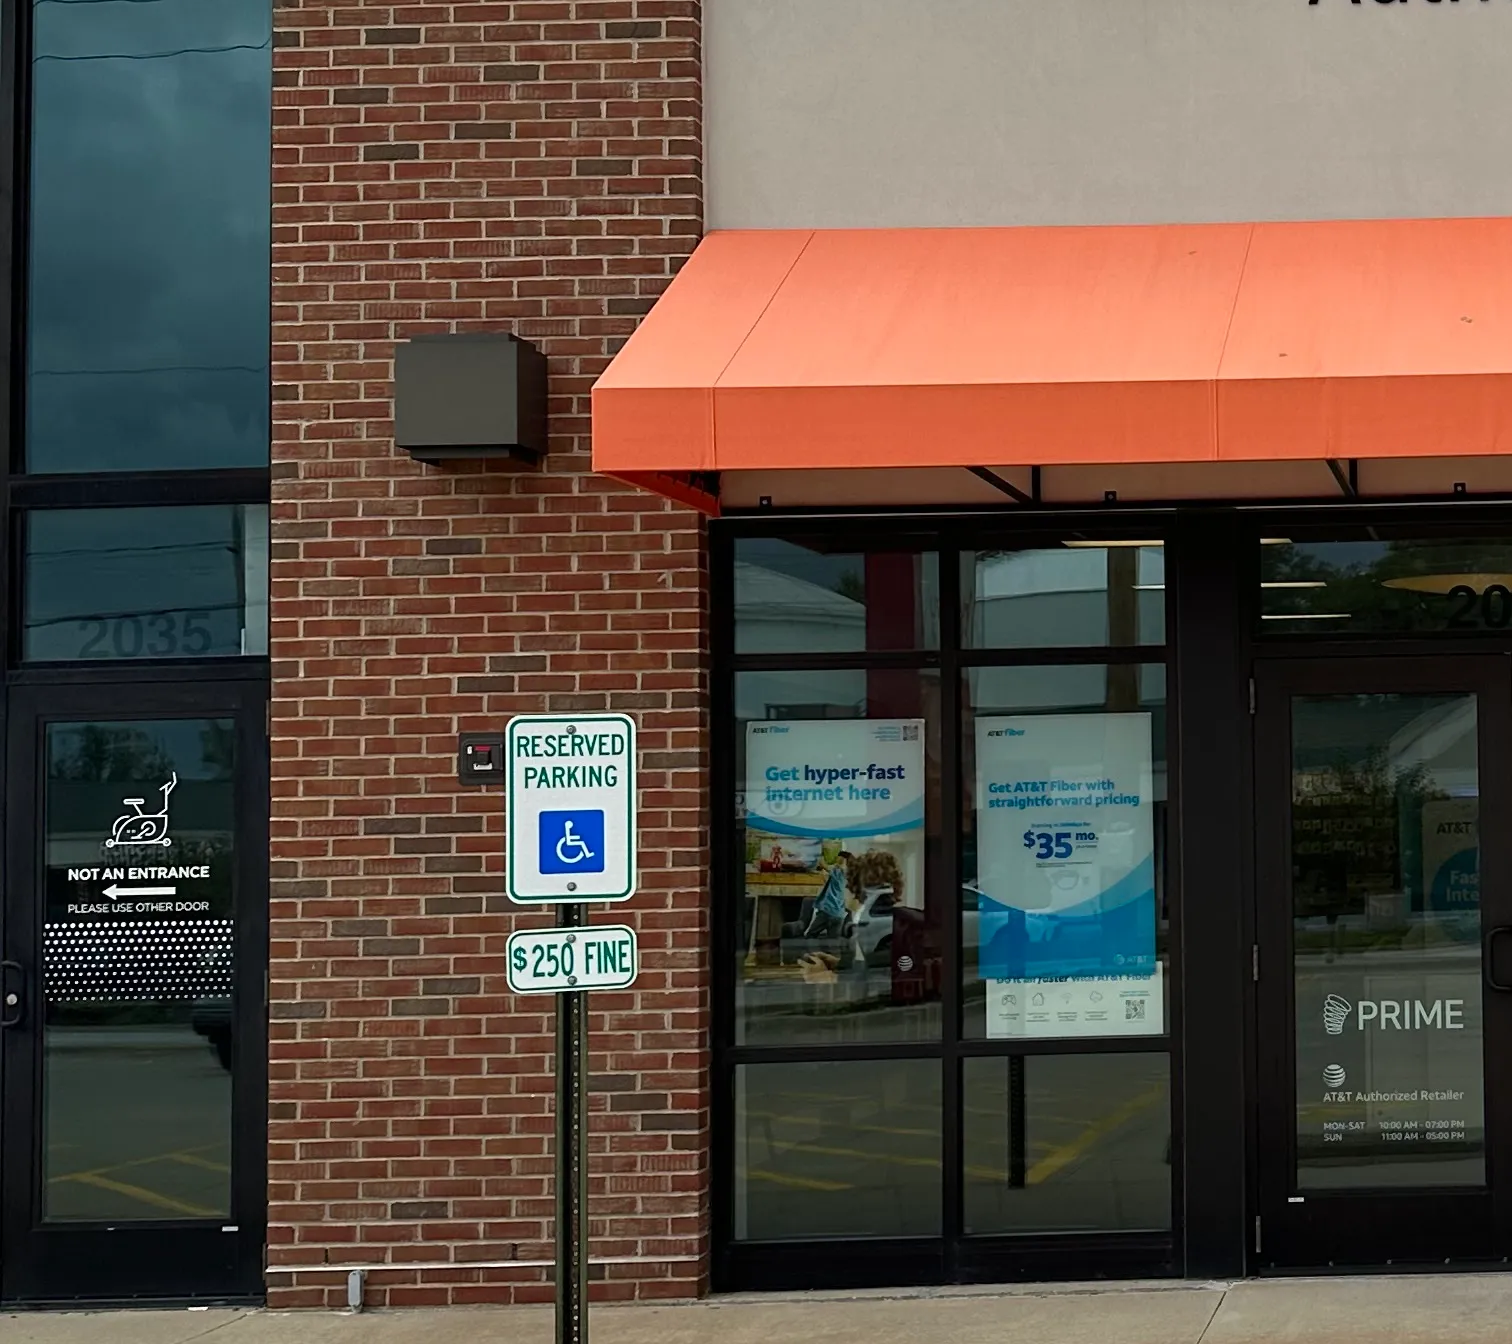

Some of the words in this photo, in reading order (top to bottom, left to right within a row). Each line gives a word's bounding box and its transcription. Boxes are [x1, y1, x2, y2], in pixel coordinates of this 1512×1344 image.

[78, 611, 213, 659] 2035
[516, 733, 625, 758] RESERVED
[524, 765, 618, 789] PARKING
[765, 765, 800, 782] Get
[804, 763, 905, 785] hyper-fast
[766, 785, 844, 802] internet
[848, 784, 891, 801] here
[988, 782, 1012, 794] Get
[1014, 781, 1048, 794] AT&T
[1050, 779, 1082, 793] Fiber
[1085, 778, 1115, 792] with
[988, 794, 1093, 810] straightforward
[1095, 792, 1140, 808] pricing
[1436, 821, 1473, 835] AT&T
[1023, 829, 1073, 860] $35
[1075, 831, 1099, 842] mo.
[67, 867, 100, 882] NOT
[101, 867, 125, 881] AN
[128, 865, 211, 880] ENTRANCE
[67, 903, 110, 914] PLEASE
[111, 902, 134, 913] USE
[135, 902, 174, 912] OTHER
[175, 901, 210, 912] DOOR
[584, 940, 631, 975] FINE
[1357, 999, 1465, 1031] PRIME
[1322, 1091, 1353, 1103] AT&T
[1355, 1089, 1418, 1102] Authorized
[1420, 1089, 1465, 1102] Retailer
[1323, 1121, 1366, 1131] MON-SAT
[1379, 1121, 1402, 1130] 10:00
[1402, 1120, 1418, 1130] AM
[1425, 1119, 1450, 1129] 07:00
[1450, 1119, 1465, 1129] PM
[1323, 1132, 1343, 1142] SUN
[1381, 1132, 1403, 1141] 11:00
[1403, 1131, 1419, 1141] AM
[1425, 1131, 1450, 1140] 05:00
[1450, 1131, 1465, 1140] PM
